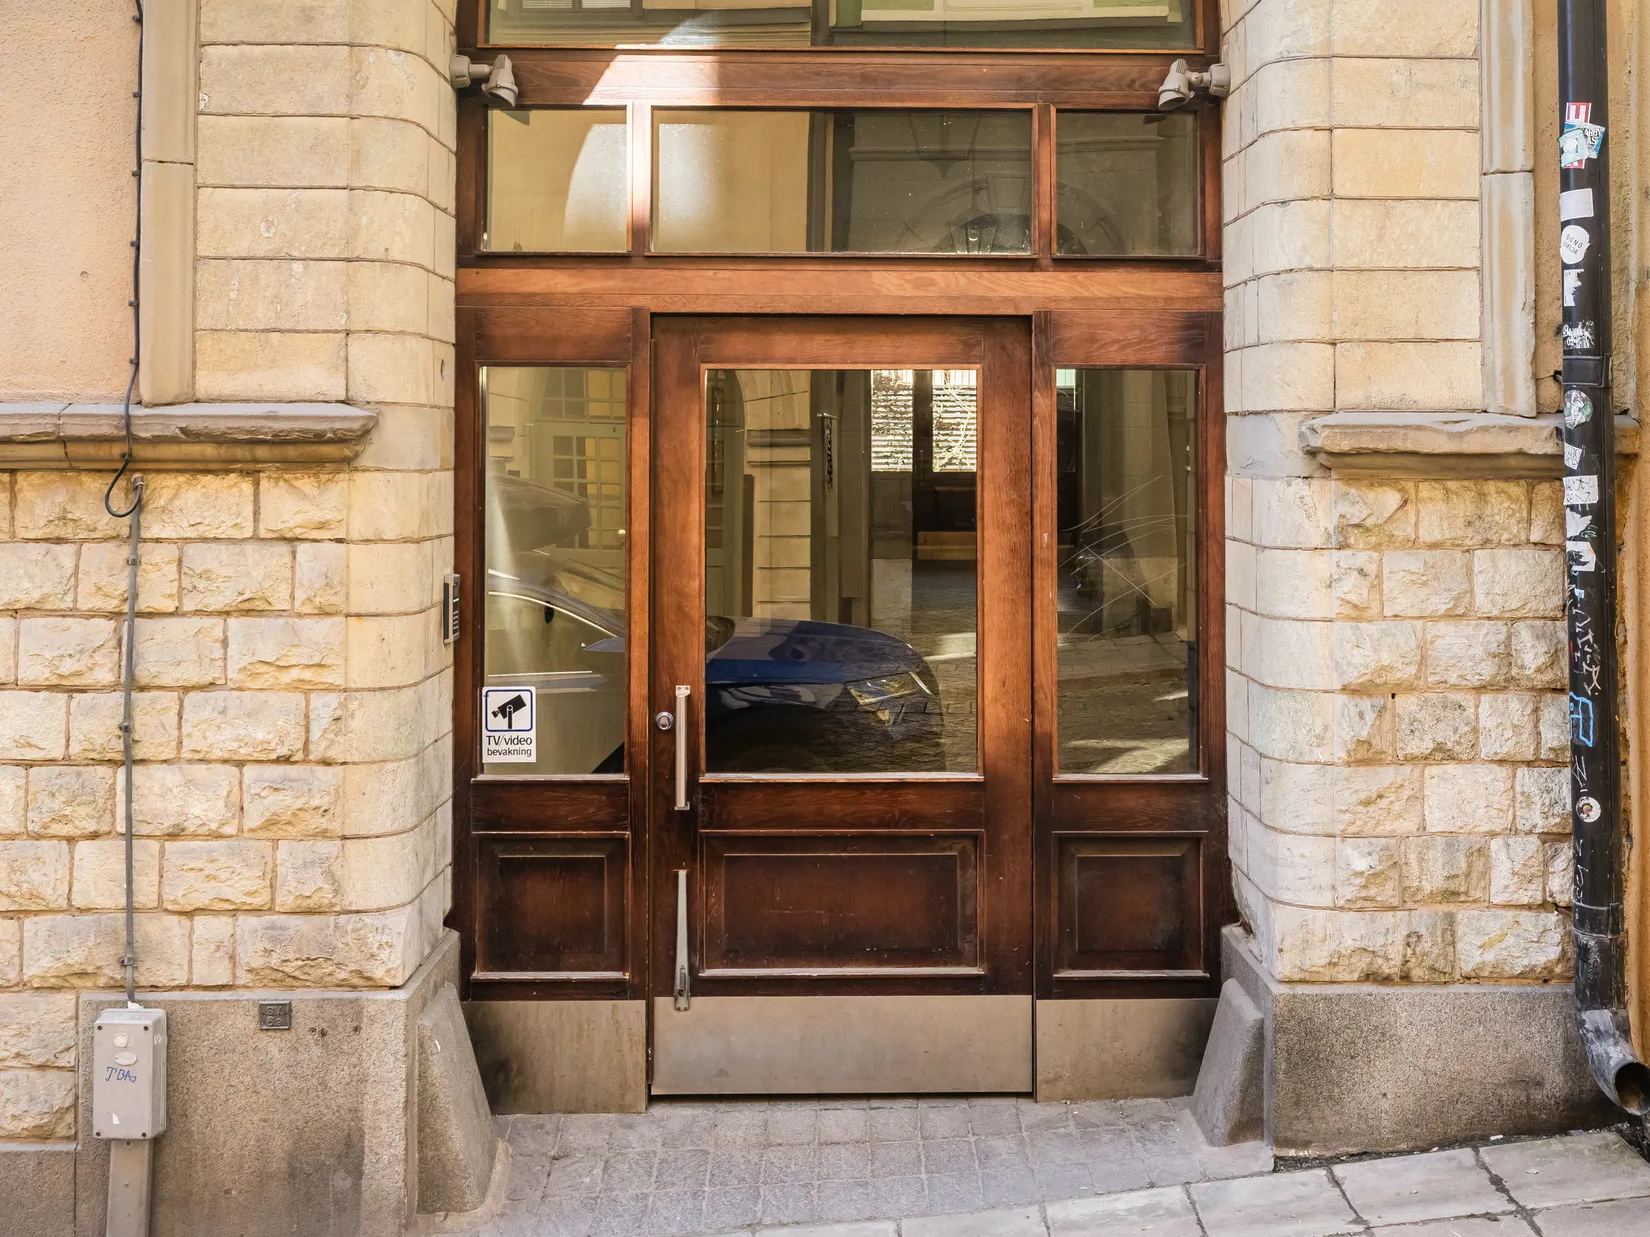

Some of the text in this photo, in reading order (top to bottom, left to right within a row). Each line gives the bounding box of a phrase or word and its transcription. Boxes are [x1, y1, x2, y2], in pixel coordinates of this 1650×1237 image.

[1565, 234, 1583, 249] SONO
[486, 735, 533, 746] TV/video
[487, 747, 532, 757] bevakning
